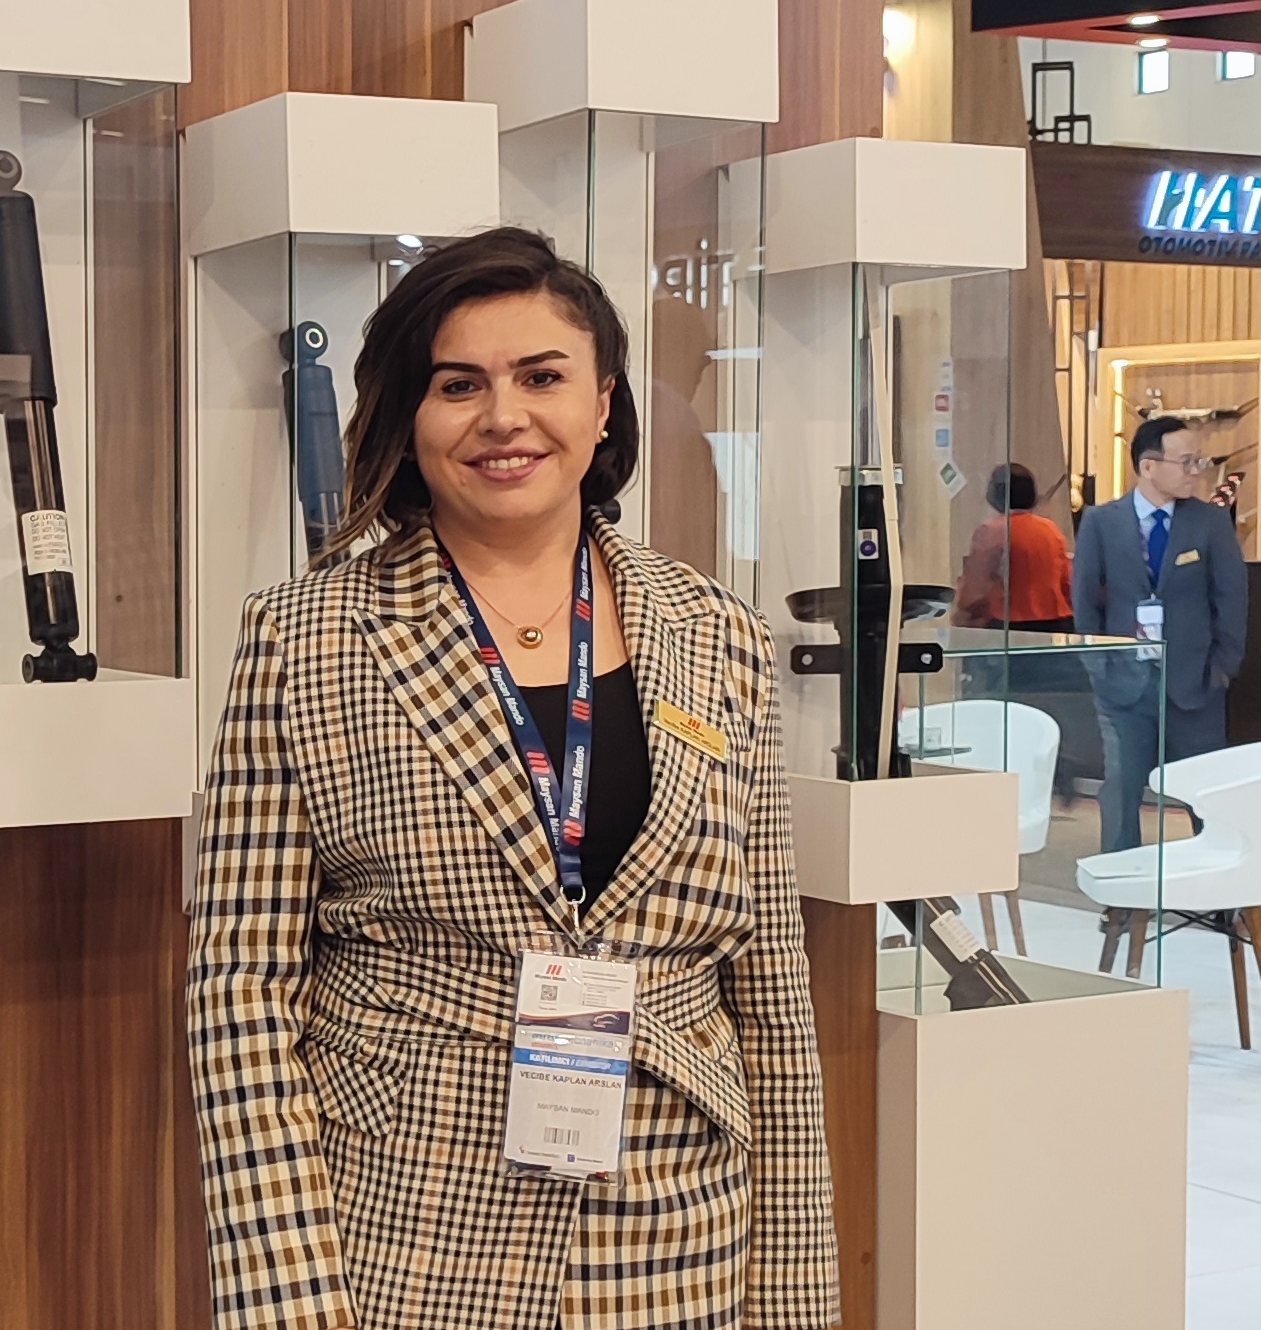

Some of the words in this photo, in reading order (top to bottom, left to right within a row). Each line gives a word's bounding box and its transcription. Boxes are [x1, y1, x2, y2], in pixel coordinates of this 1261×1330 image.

[577, 641, 588, 668] Mando
[490, 666, 511, 697] Maysan
[505, 697, 525, 726] Mando
[577, 668, 590, 699] Maysan
[572, 745, 585, 778] Mando
[538, 776, 556, 816] Maysan
[569, 778, 584, 819] Maysan
